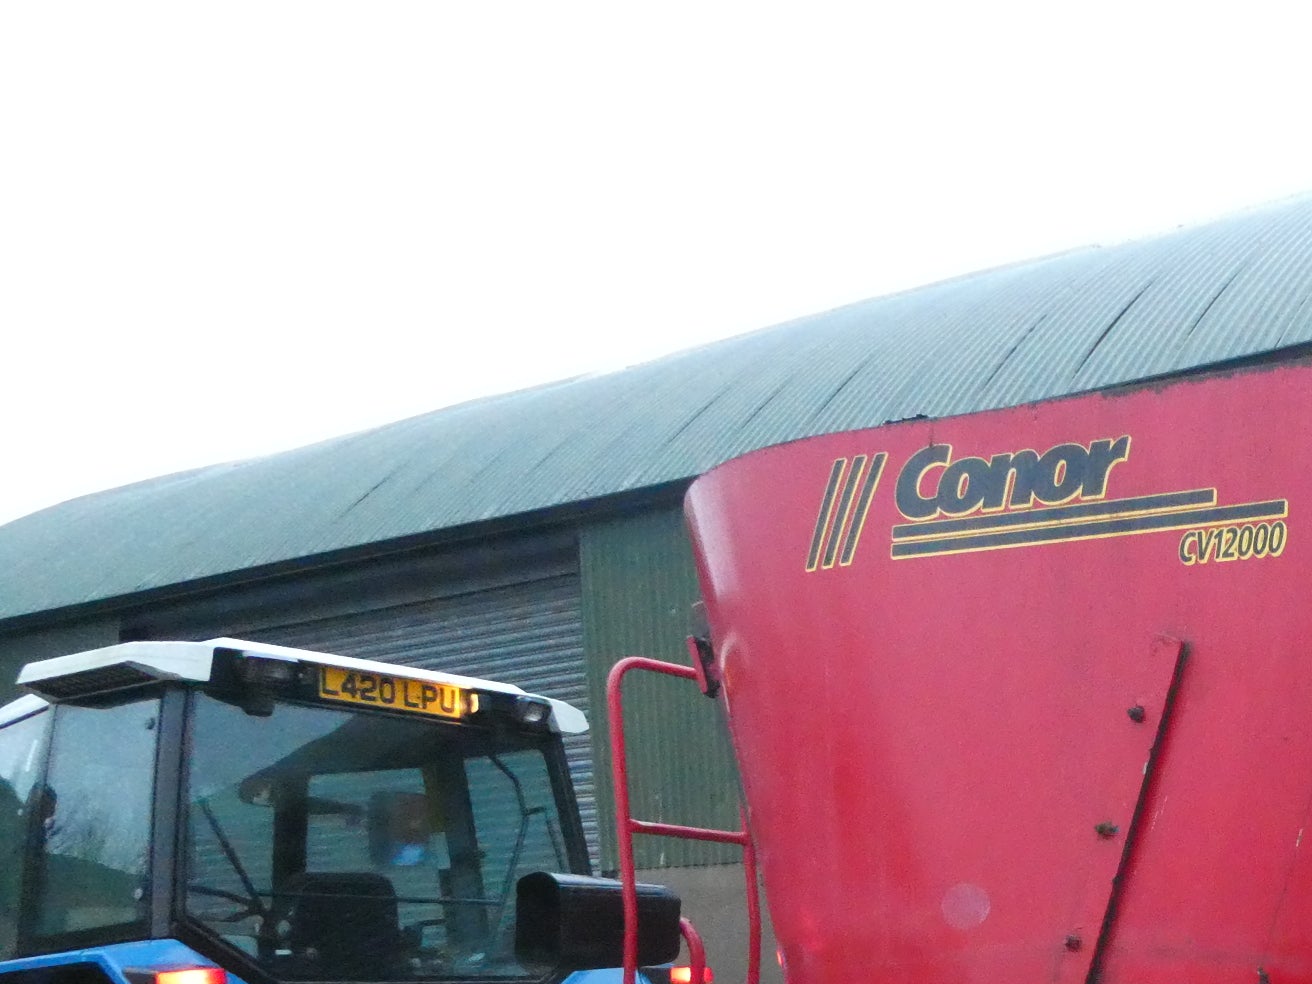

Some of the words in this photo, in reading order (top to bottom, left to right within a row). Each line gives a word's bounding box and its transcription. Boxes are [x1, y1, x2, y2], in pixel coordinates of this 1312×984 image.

[895, 434, 1132, 520] Conor
[1179, 521, 1288, 565] CV12000
[321, 667, 396, 704] L420
[403, 681, 456, 714] LPU
